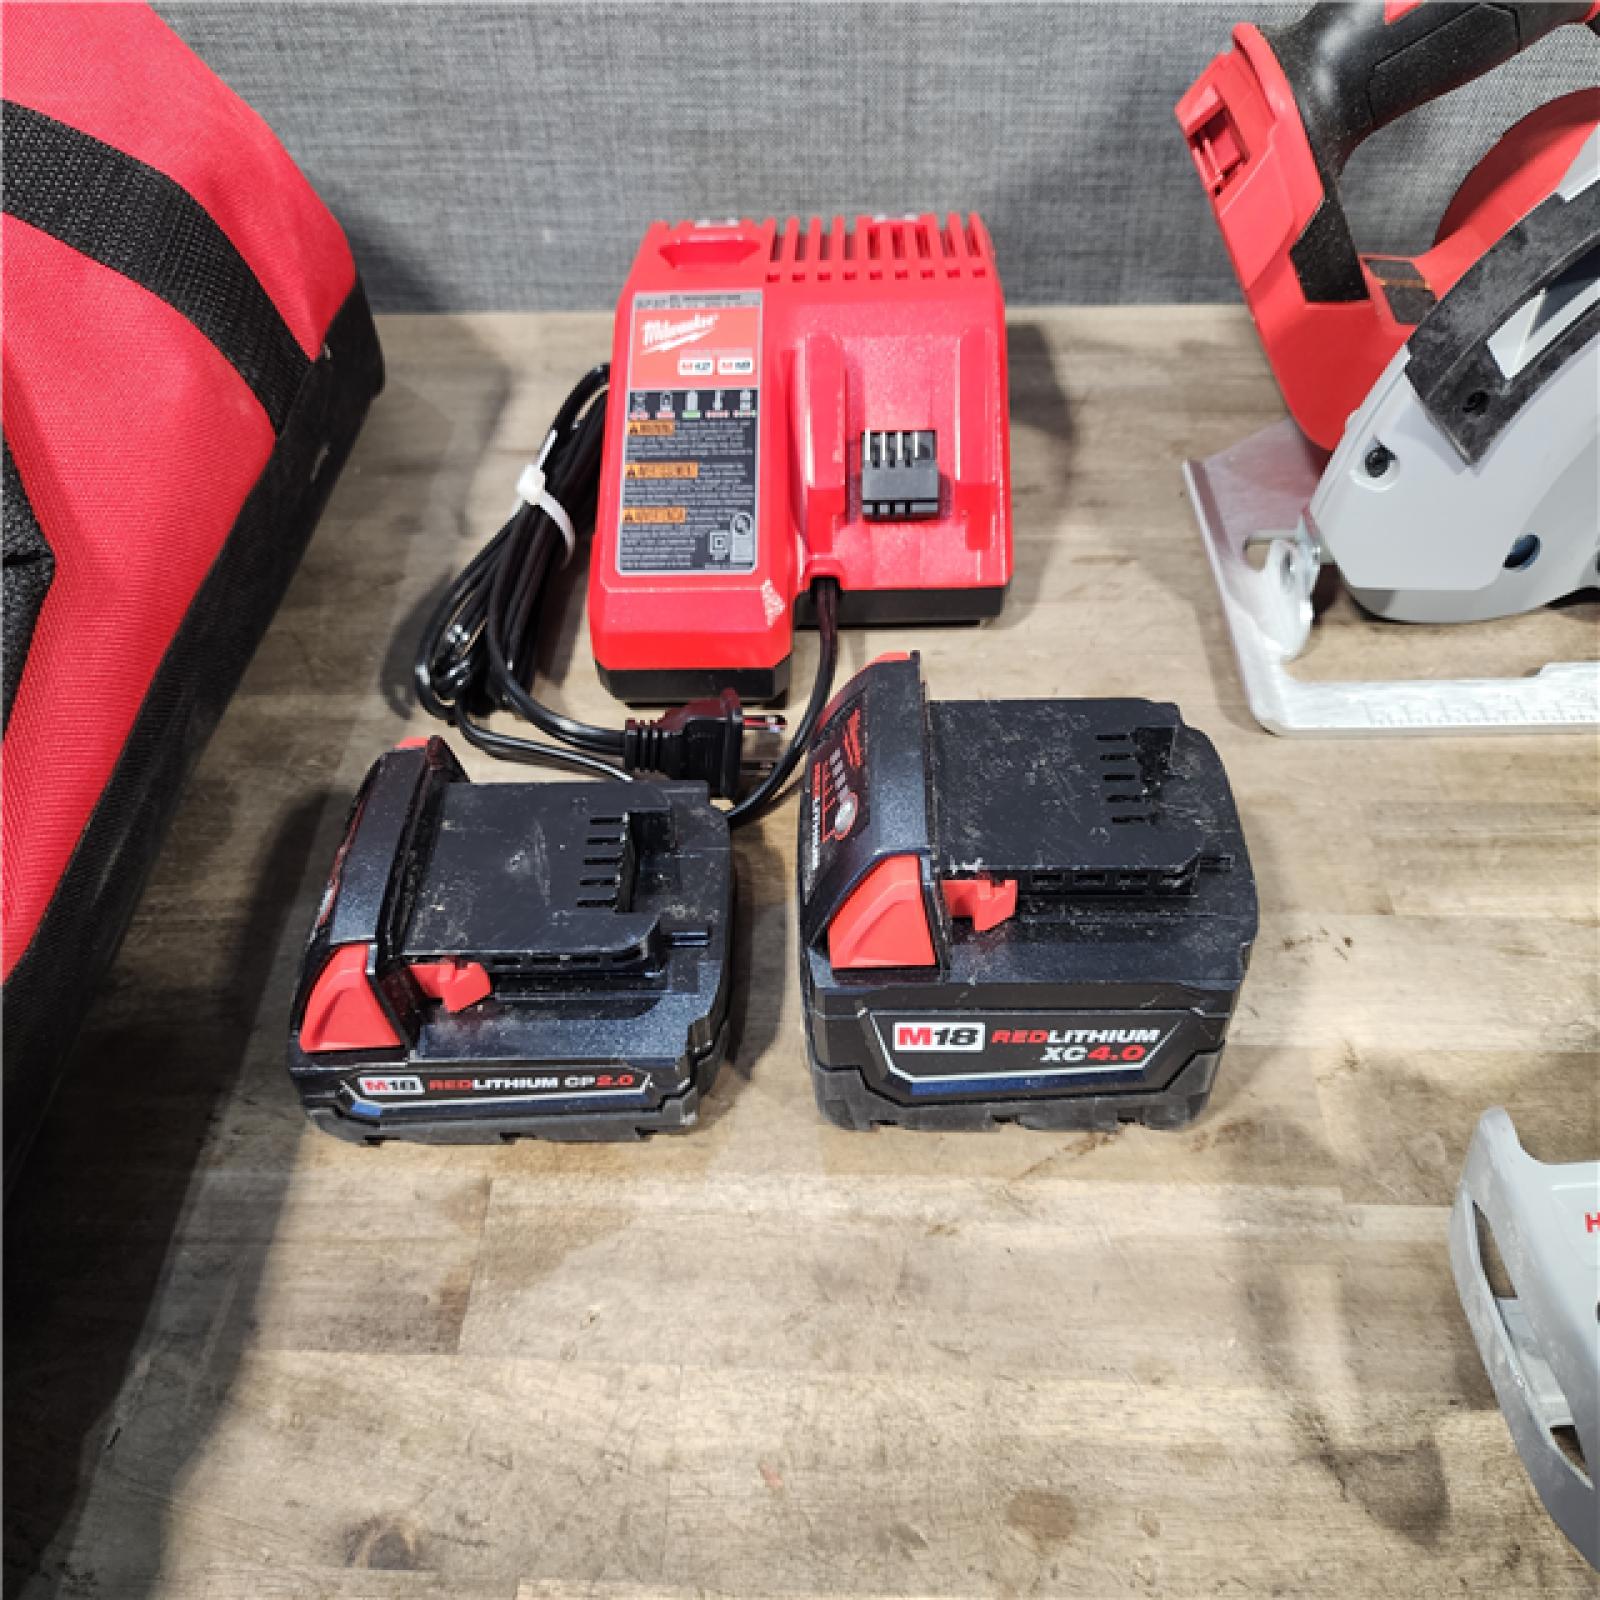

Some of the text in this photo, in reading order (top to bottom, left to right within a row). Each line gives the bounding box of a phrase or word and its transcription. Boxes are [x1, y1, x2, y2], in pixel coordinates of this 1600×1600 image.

[897, 1027, 1160, 1046] M18 REDLITHIUM
[1040, 1045, 1146, 1061] XC4.0
[429, 1077, 559, 1090] REDLITHIUM
